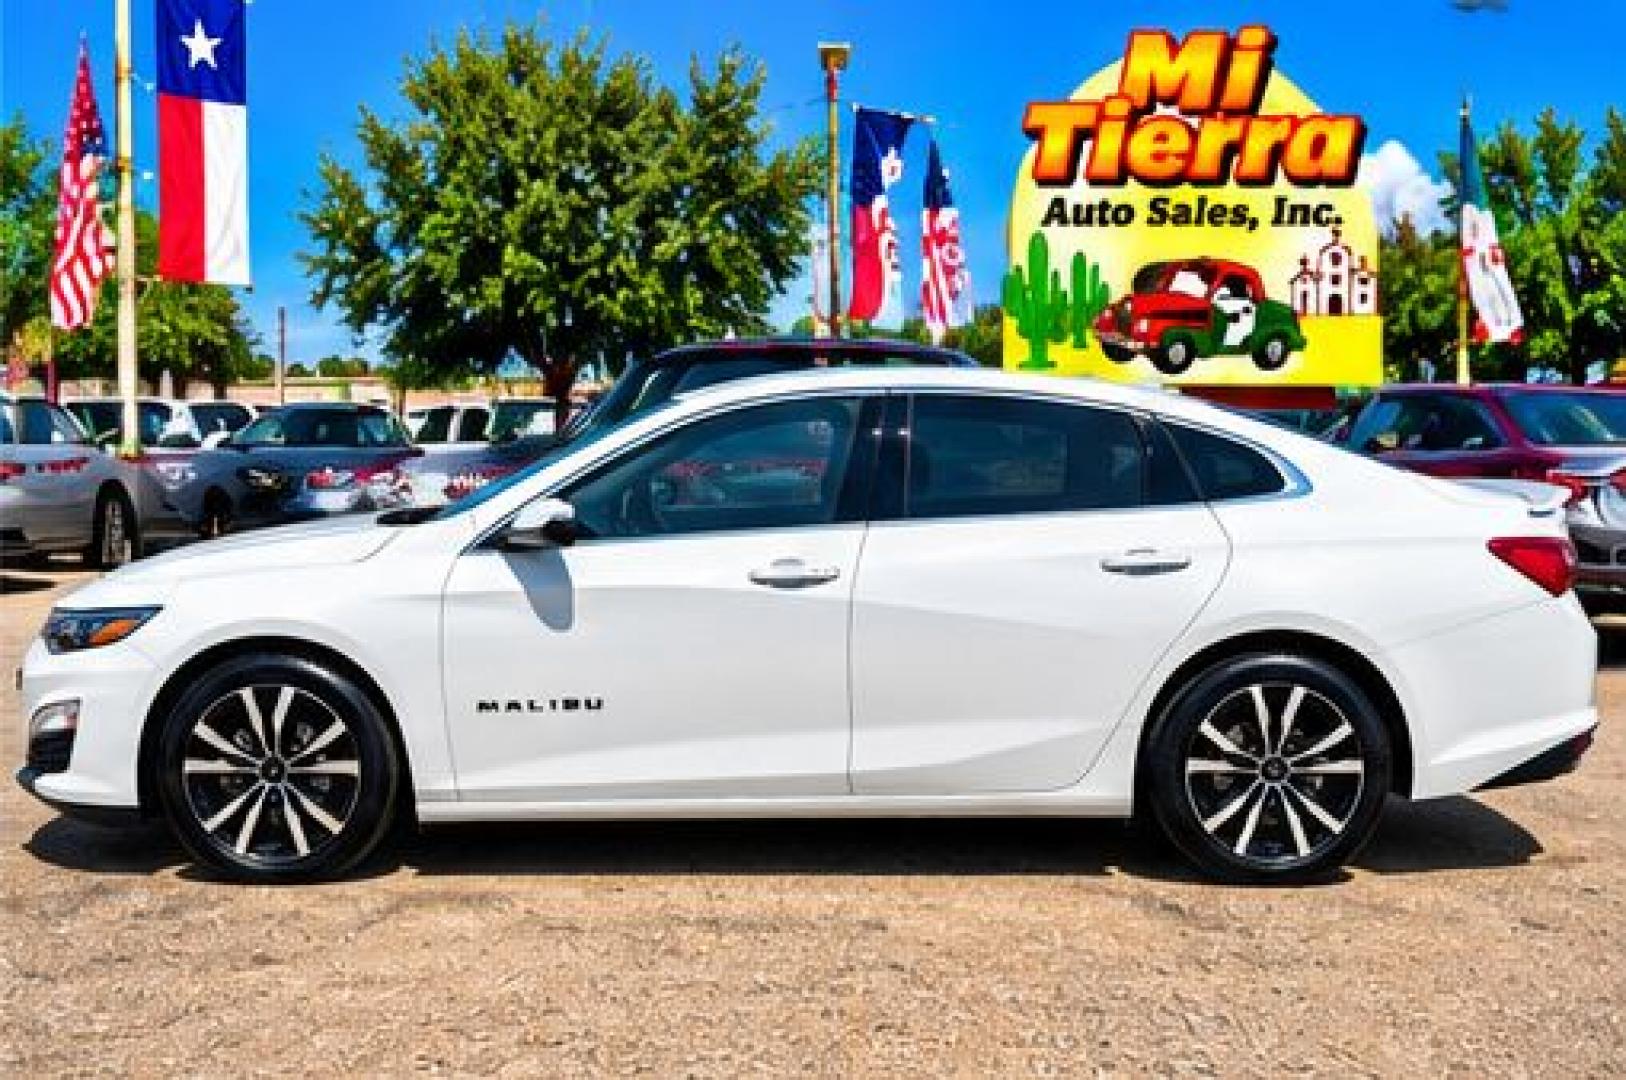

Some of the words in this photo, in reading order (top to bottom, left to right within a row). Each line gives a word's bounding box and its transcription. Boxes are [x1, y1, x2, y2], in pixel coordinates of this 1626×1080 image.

[1118, 24, 1278, 117] Mi
[1022, 95, 1367, 188] Tierra
[1041, 196, 1135, 228] Auto
[1146, 196, 1259, 232] Sales,
[1271, 196, 1344, 228] Inc.
[476, 697, 604, 713] MALIBU
